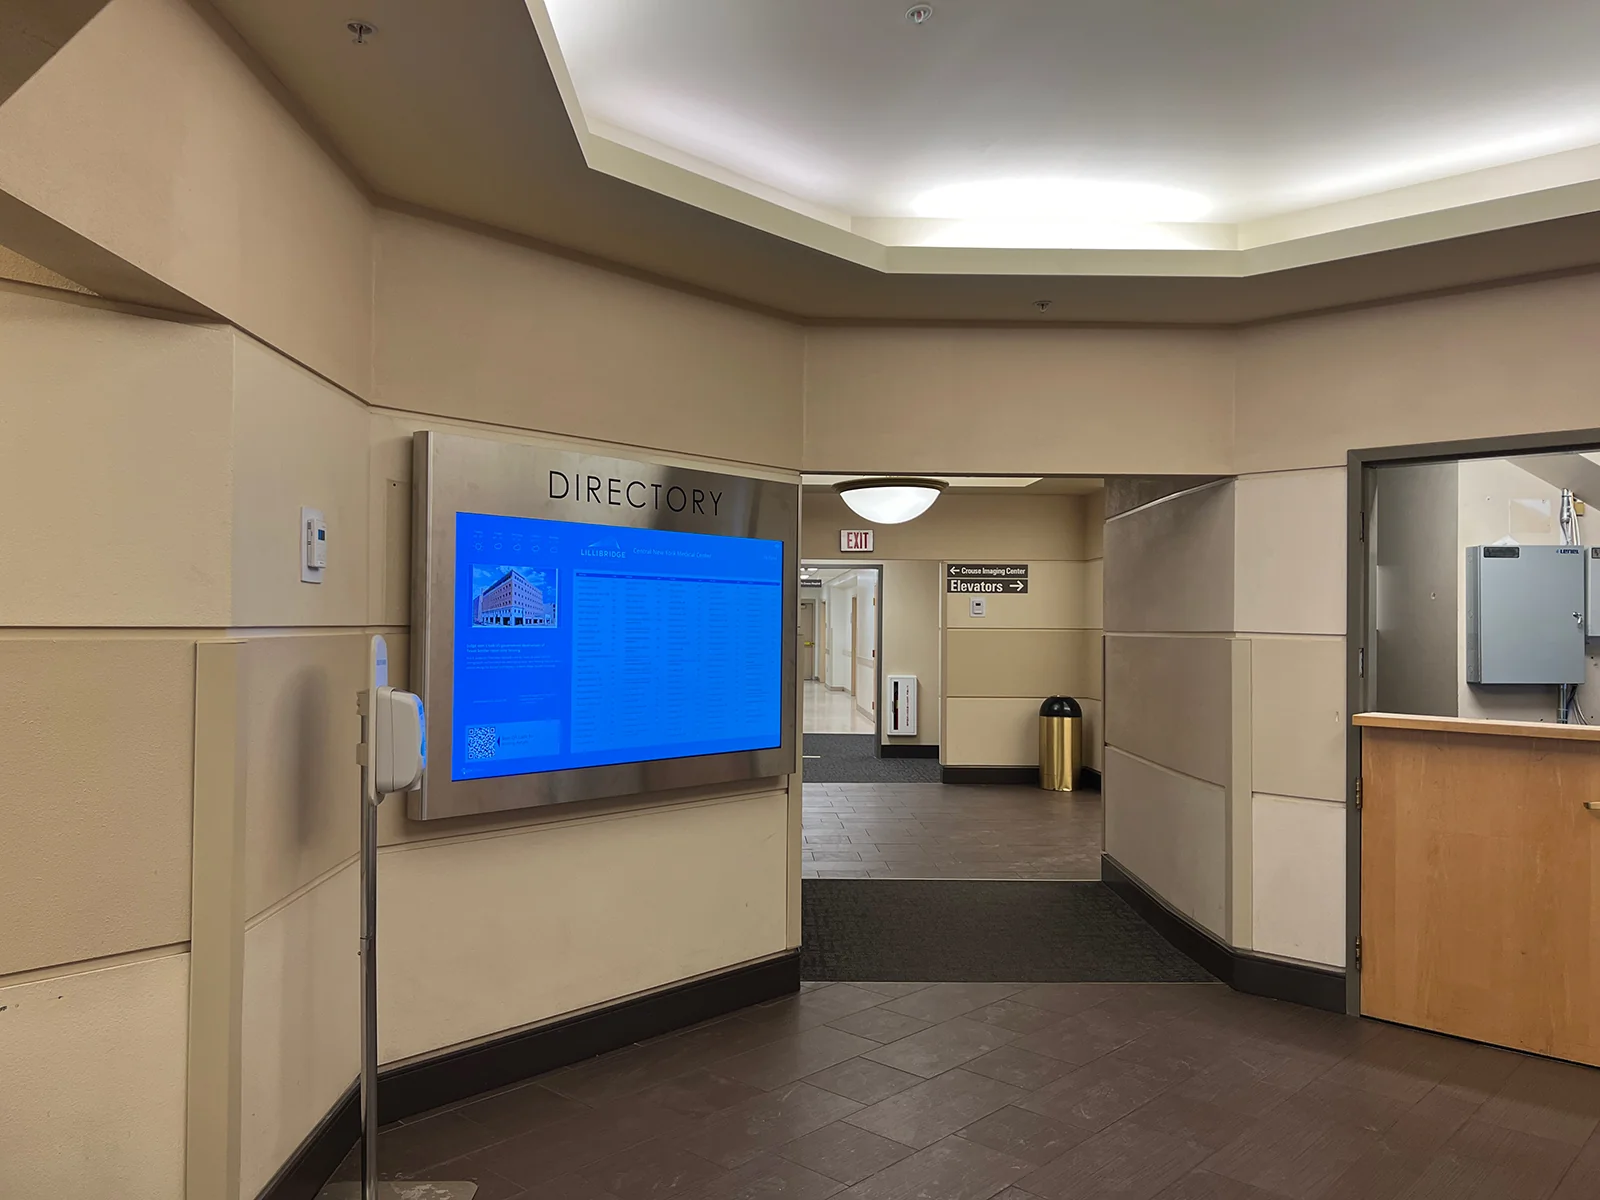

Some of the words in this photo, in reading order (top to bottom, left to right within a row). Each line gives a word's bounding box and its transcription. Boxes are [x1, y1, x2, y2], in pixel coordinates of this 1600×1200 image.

[549, 470, 723, 516] DIRECTORY
[847, 532, 869, 549] EXIT
[580, 549, 626, 559] LILLIBRIDGE
[633, 547, 652, 555] Central
[961, 567, 981, 575] Crouse
[982, 567, 1005, 576] Imaging
[1006, 567, 1025, 575] Center
[951, 580, 1003, 592] Elevators
